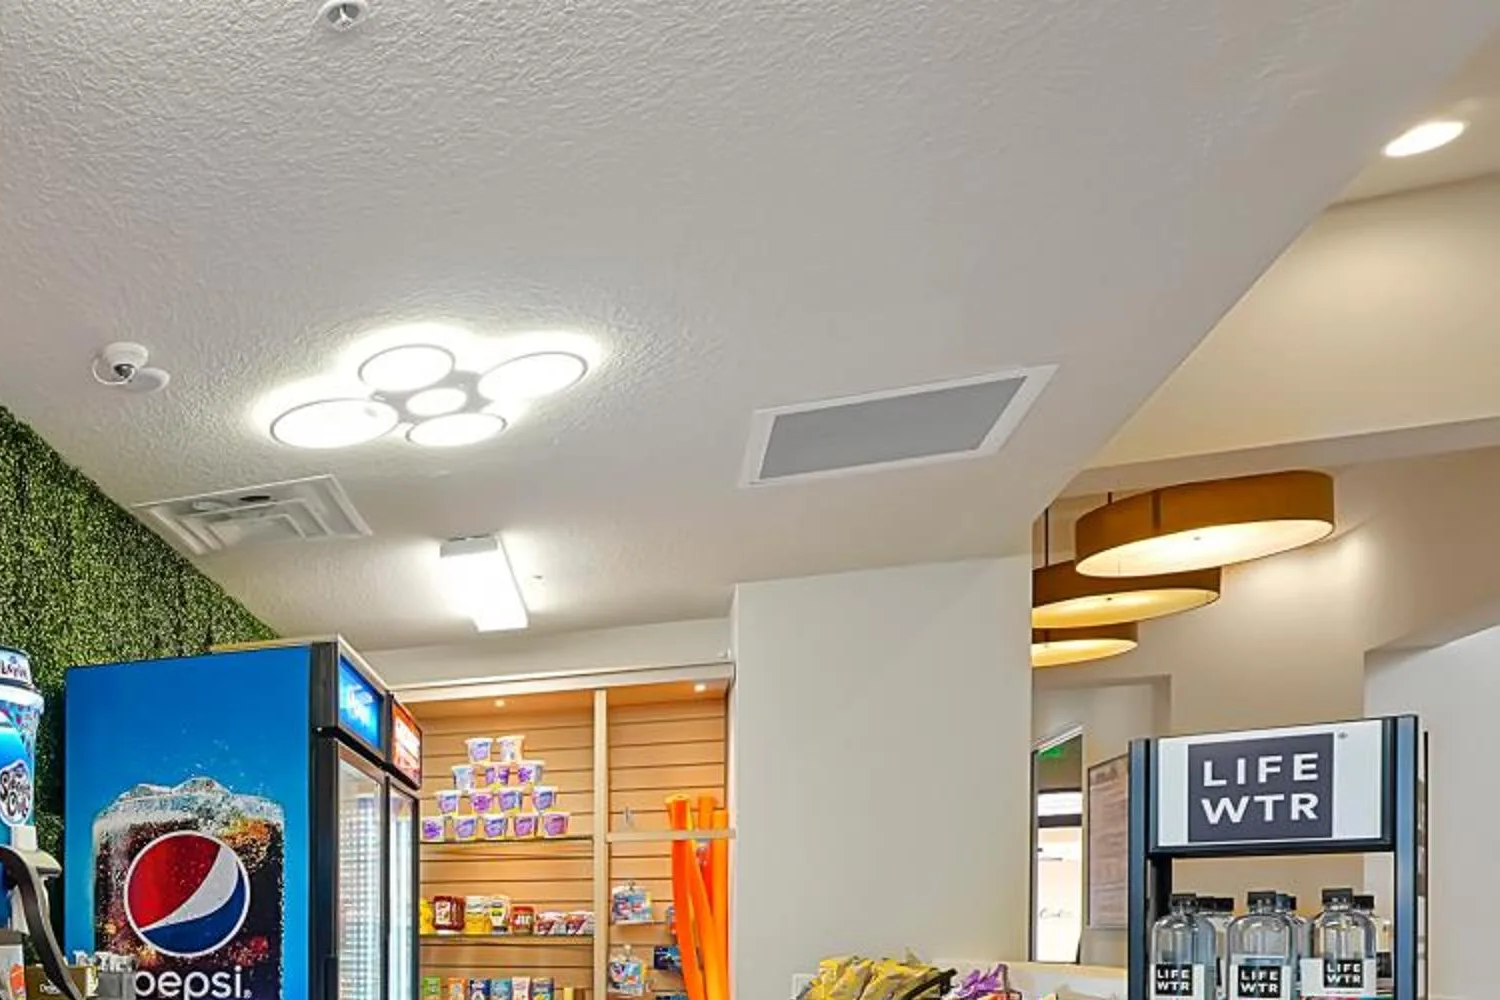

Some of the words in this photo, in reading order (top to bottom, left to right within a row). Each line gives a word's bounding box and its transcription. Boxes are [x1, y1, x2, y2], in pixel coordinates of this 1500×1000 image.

[1203, 752, 1319, 787] LIFE
[1201, 793, 1319, 825] WTR
[1327, 963, 1360, 973] LIFE
[1157, 969, 1190, 979] LIFE
[1241, 971, 1278, 981] LIFE
[1327, 974, 1361, 984] WTR
[1157, 981, 1190, 991] WTR
[1240, 983, 1279, 993] WTR
